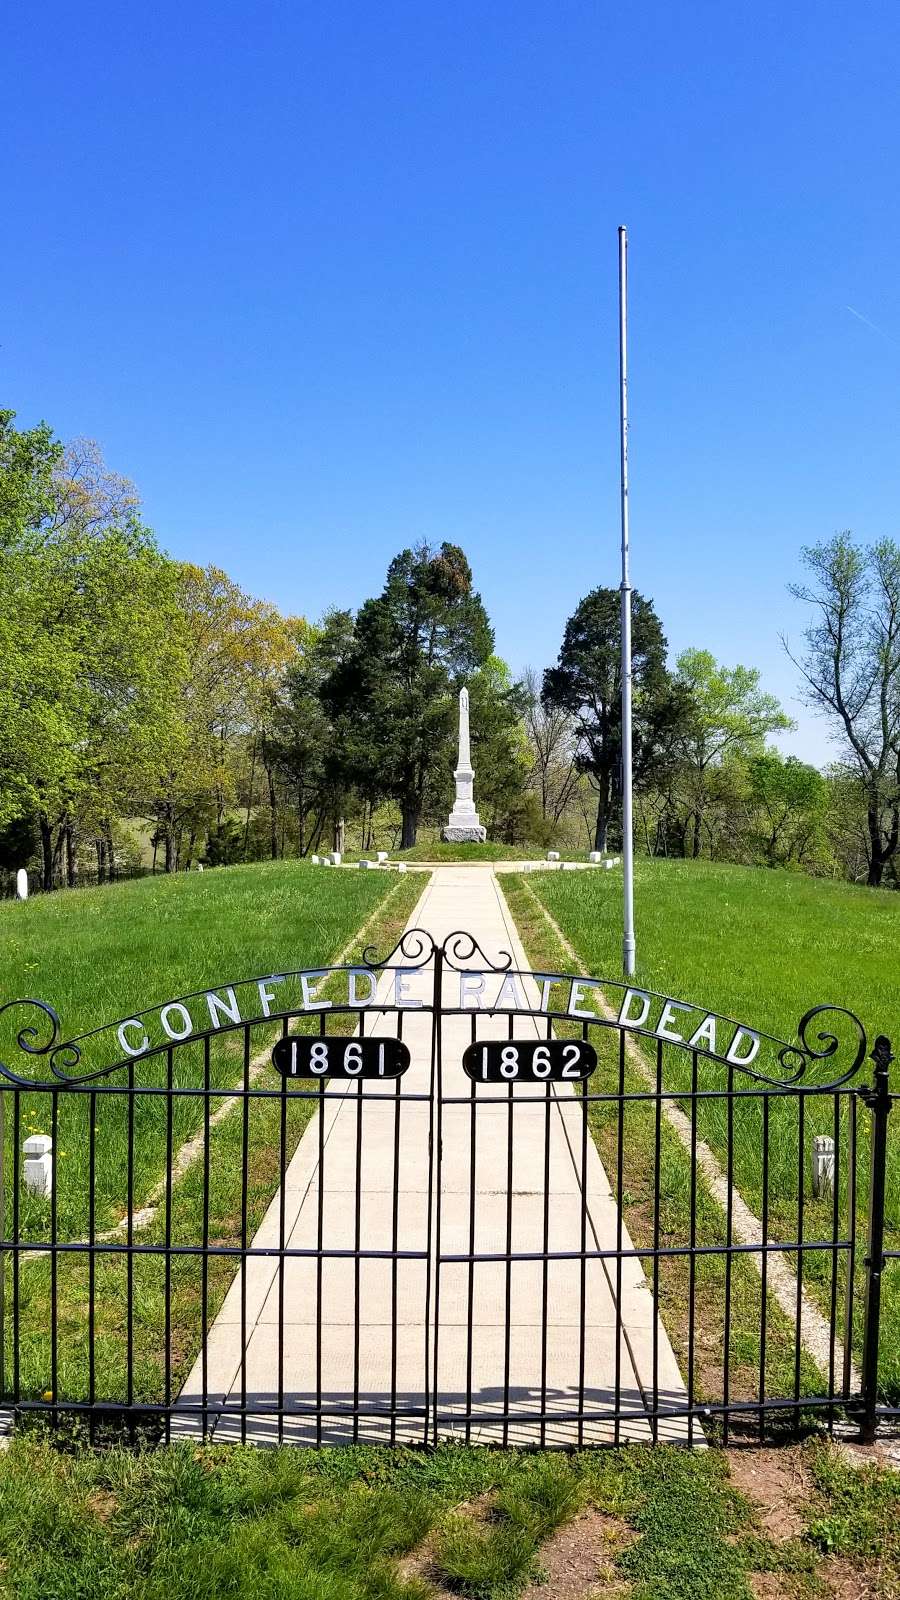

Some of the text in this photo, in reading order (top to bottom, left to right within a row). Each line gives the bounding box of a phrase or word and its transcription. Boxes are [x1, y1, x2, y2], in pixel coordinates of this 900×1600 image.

[618, 988, 761, 1065] DEAD
[291, 1042, 385, 1076] 1861
[482, 1045, 581, 1079] 1862
